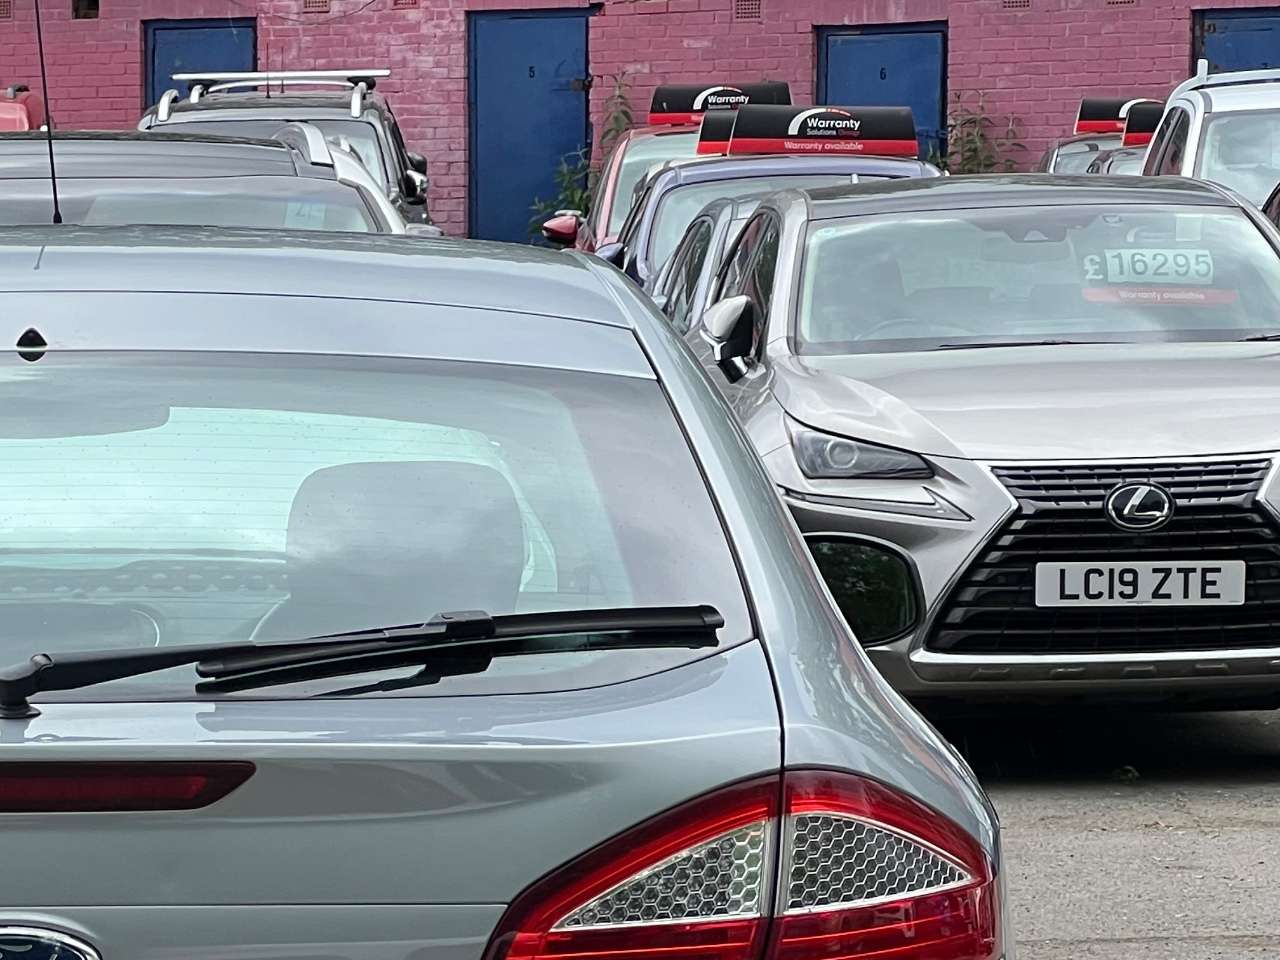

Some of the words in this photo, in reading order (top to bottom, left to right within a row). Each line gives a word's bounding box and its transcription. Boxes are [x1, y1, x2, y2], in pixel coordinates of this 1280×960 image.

[528, 66, 536, 79] 5
[879, 67, 887, 81] 6
[707, 94, 750, 106] Warranty
[806, 116, 861, 131] Warranty
[806, 128, 837, 137] Solutions
[783, 140, 823, 152] Warranty
[824, 140, 864, 151] available
[1059, 567, 1139, 600] LC19
[1150, 566, 1222, 600] ZTE
